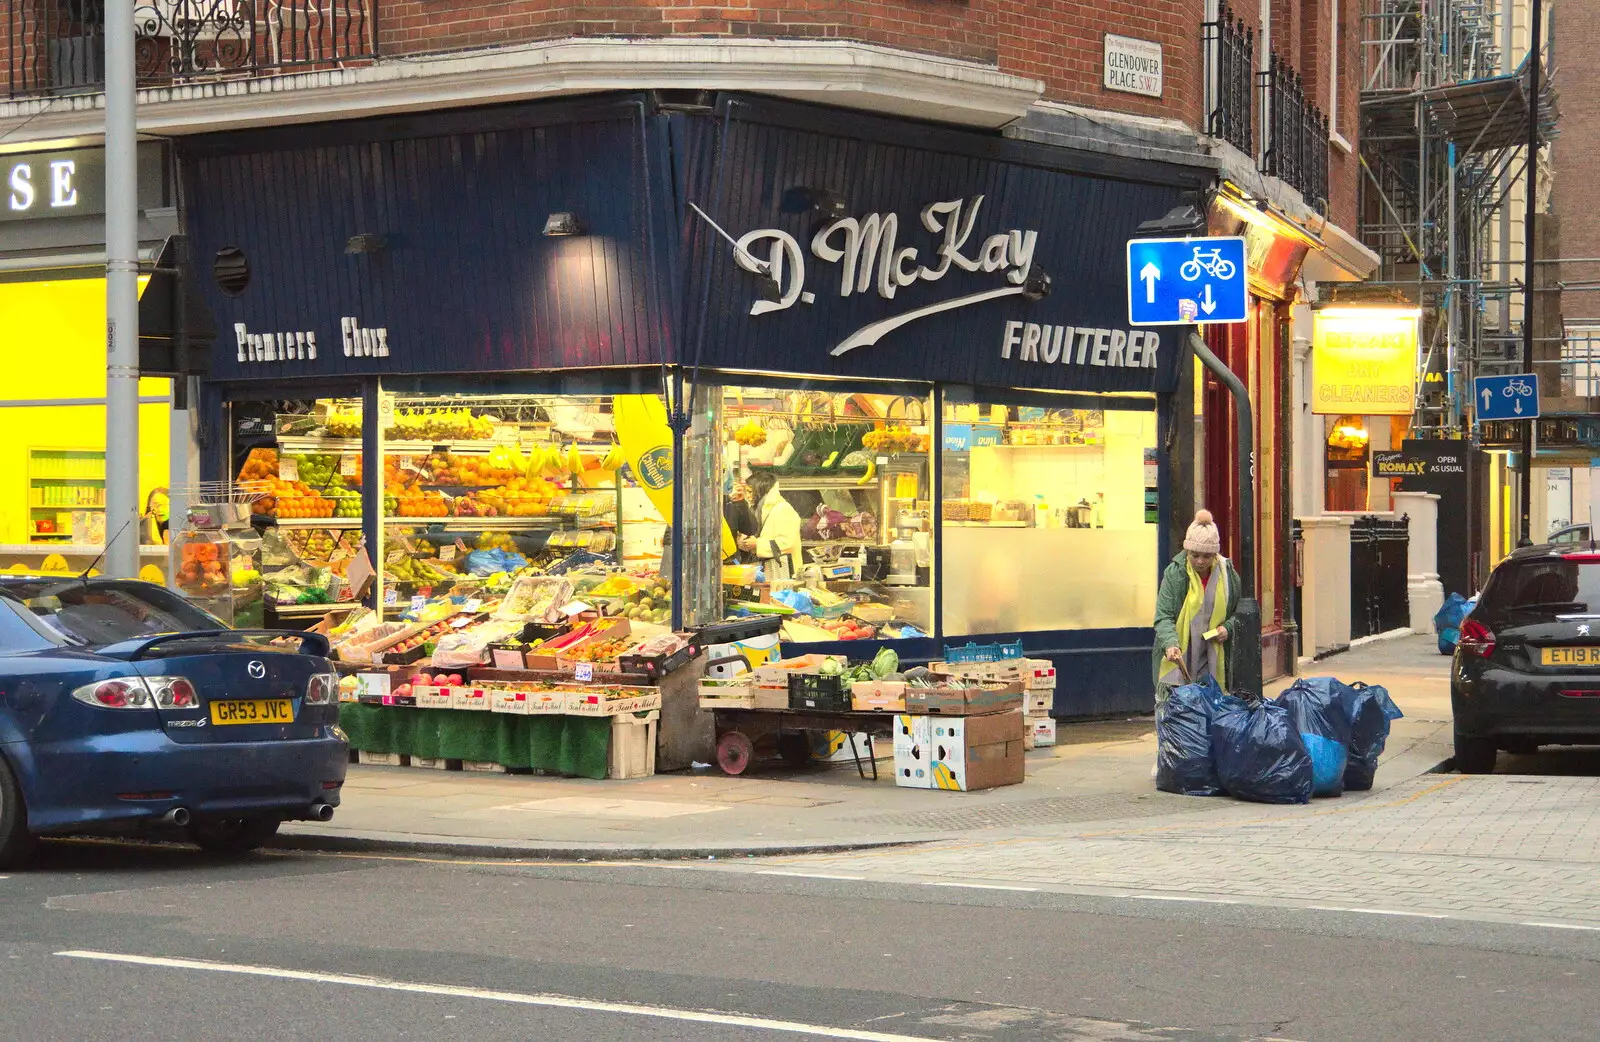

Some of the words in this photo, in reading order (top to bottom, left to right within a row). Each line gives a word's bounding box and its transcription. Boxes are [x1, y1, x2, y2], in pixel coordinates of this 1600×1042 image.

[1108, 51, 1159, 75] GLENDOWER
[811, 195, 1038, 299] McKay
[1001, 320, 1160, 368] FRUITERER
[1347, 360, 1382, 378] DRY
[1319, 384, 1410, 403] CLEANERS
[1379, 463, 1416, 472] ROMA
[1552, 648, 1586, 661] ET19
[218, 702, 257, 720] GR53
[262, 701, 288, 719] JVC
